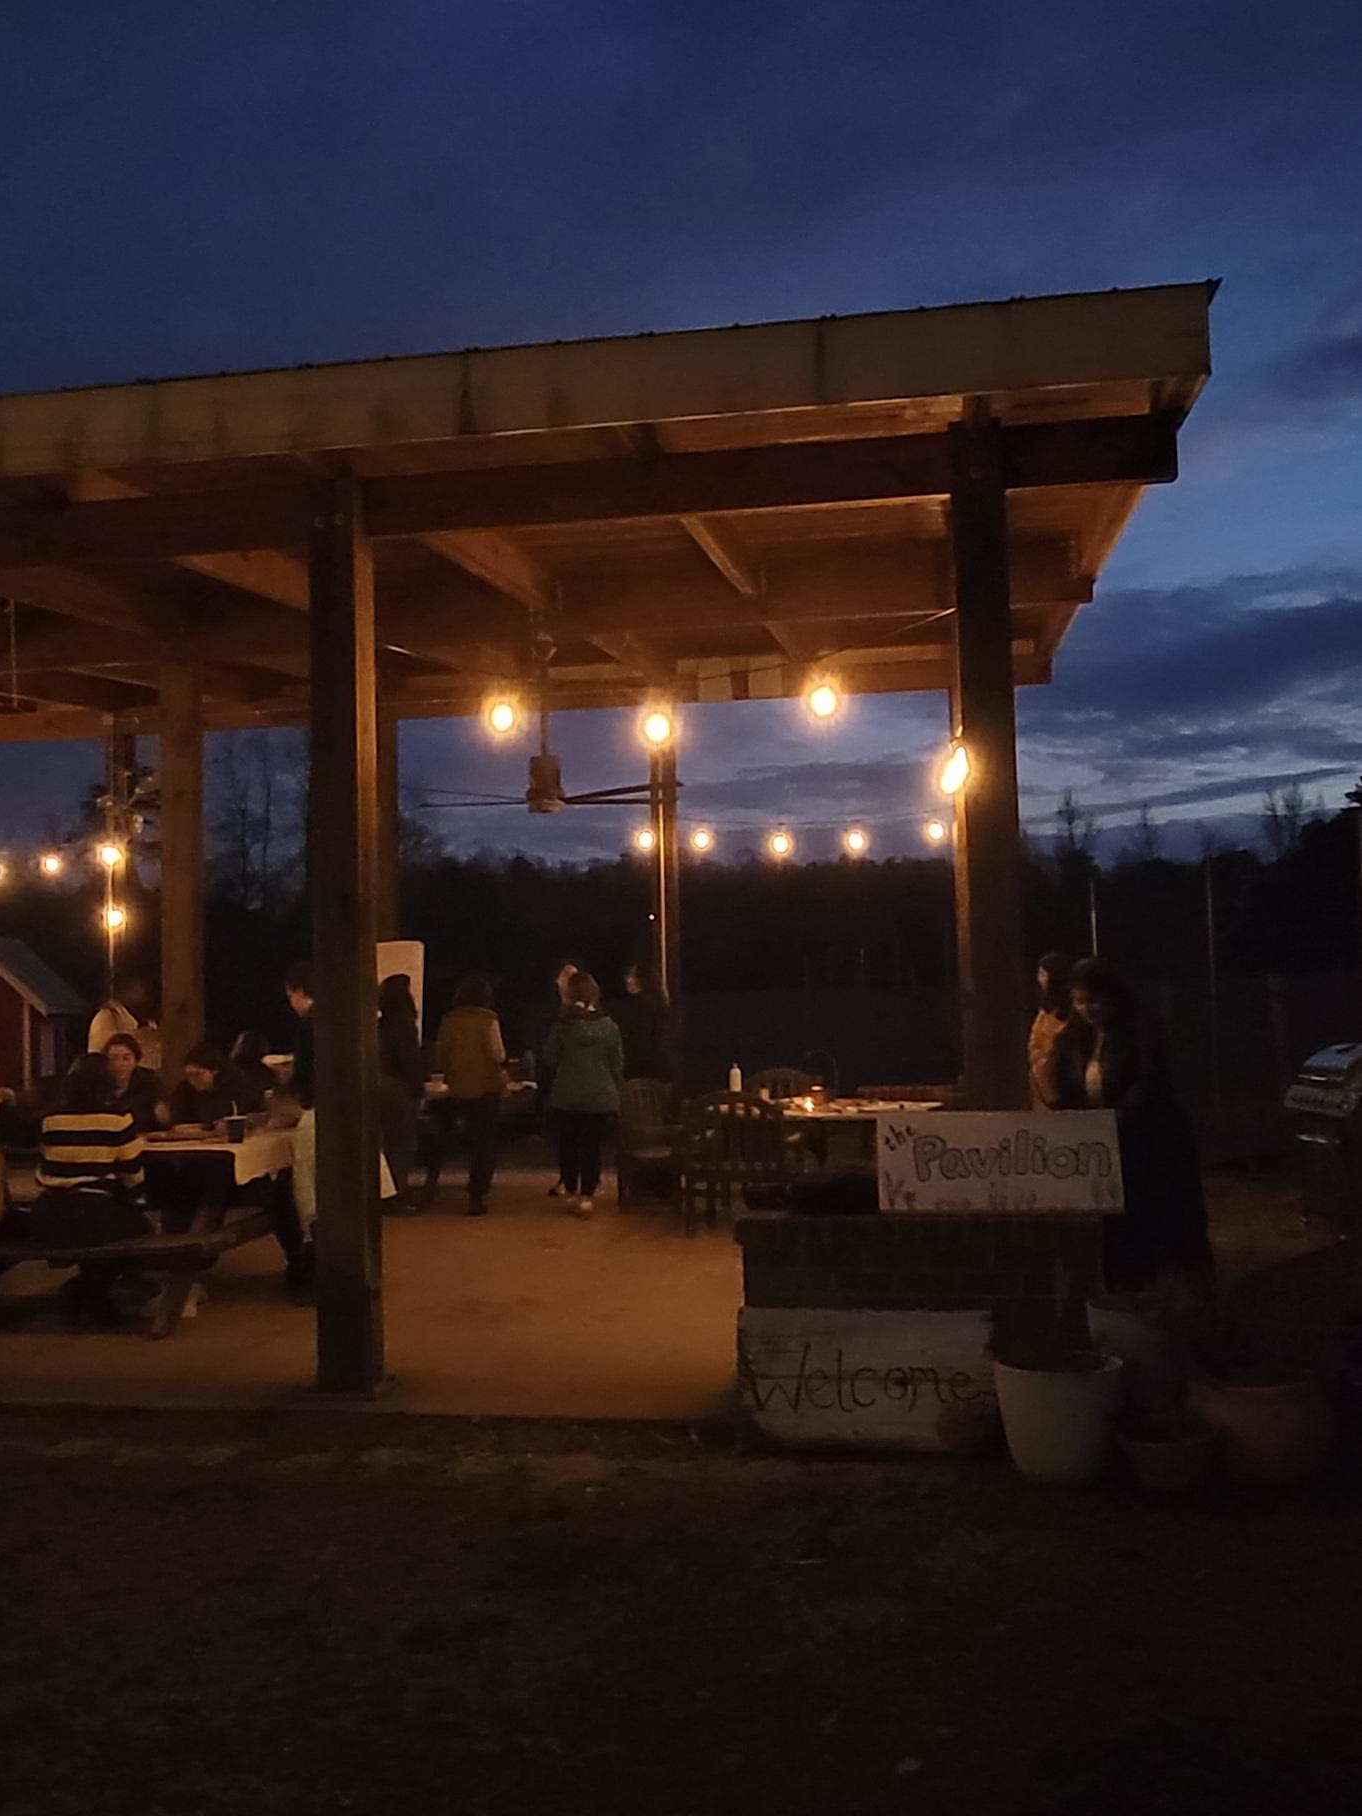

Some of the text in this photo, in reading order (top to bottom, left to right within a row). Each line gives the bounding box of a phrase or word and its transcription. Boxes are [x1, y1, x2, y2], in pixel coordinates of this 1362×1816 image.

[884, 1124, 1113, 1181] the Pavilion
[745, 1344, 976, 1413] Welcome
